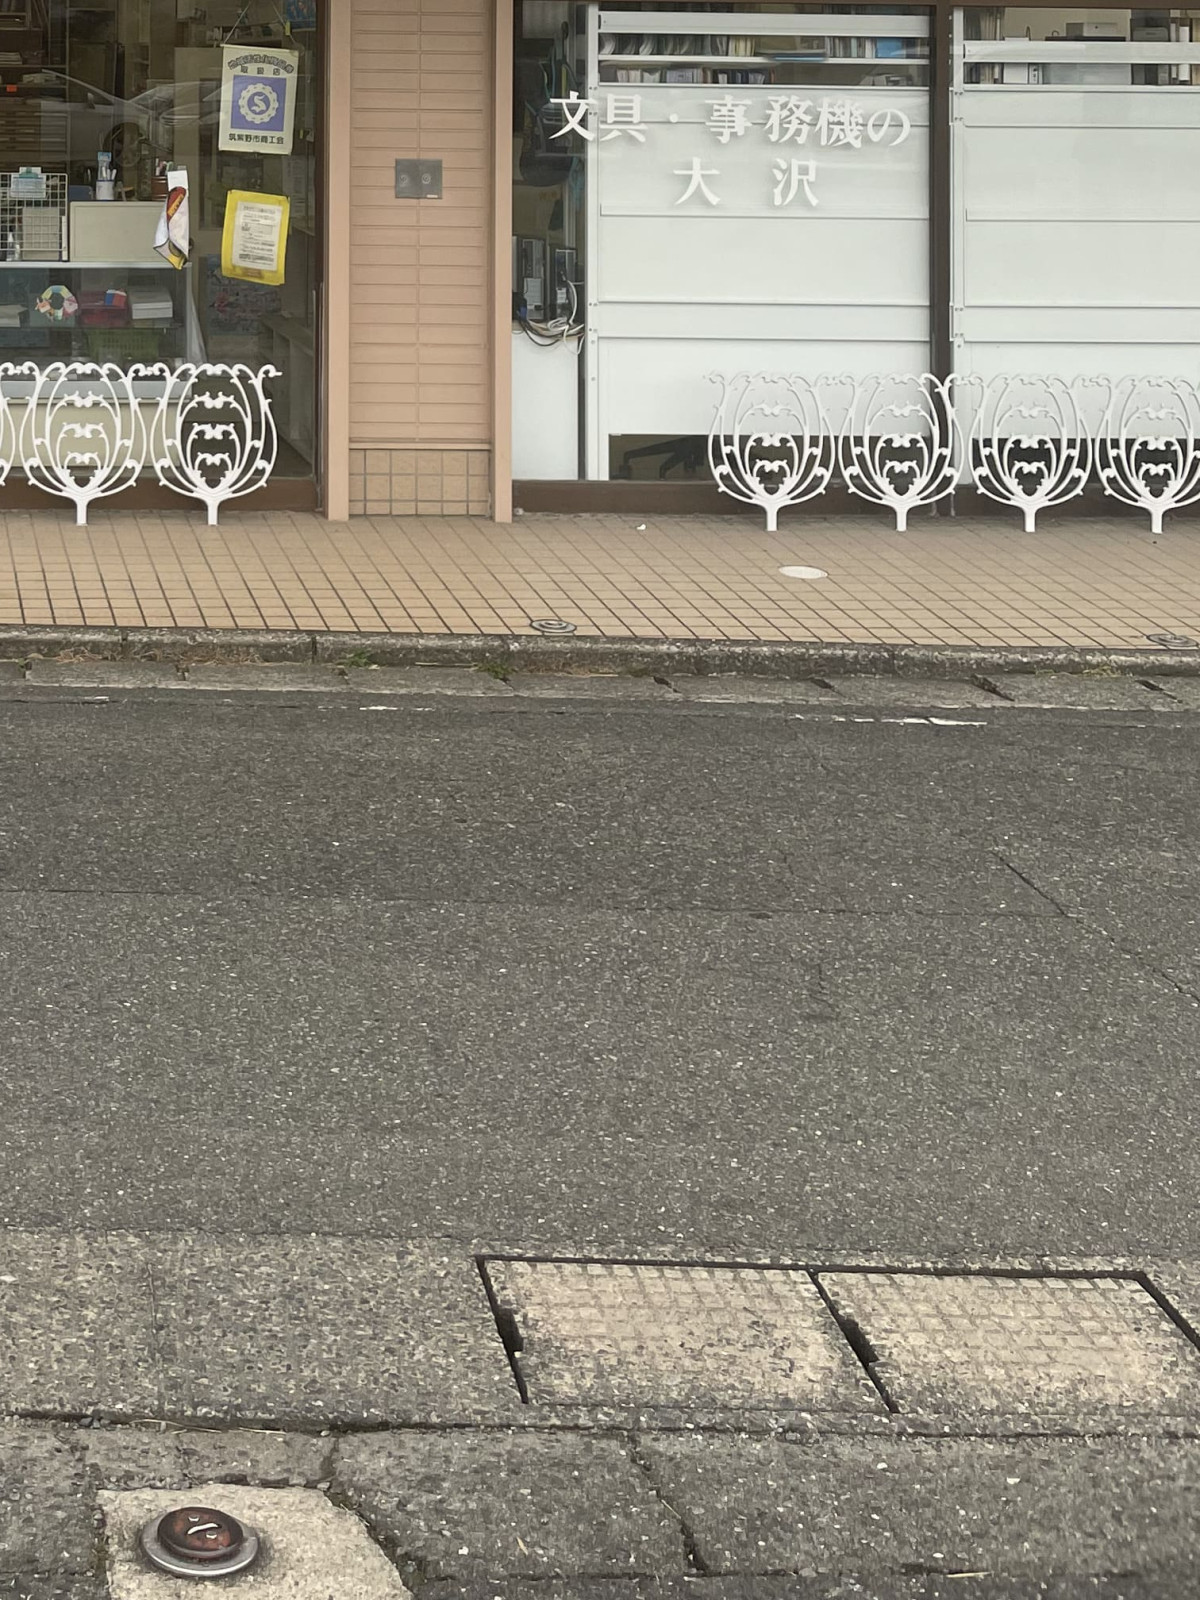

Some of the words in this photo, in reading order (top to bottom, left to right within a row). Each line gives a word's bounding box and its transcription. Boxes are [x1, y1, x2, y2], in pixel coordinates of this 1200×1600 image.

[228, 133, 285, 145] 筑紫野市商工会
[549, 90, 912, 148] 文具・事務機の
[673, 156, 821, 207] 大沢
